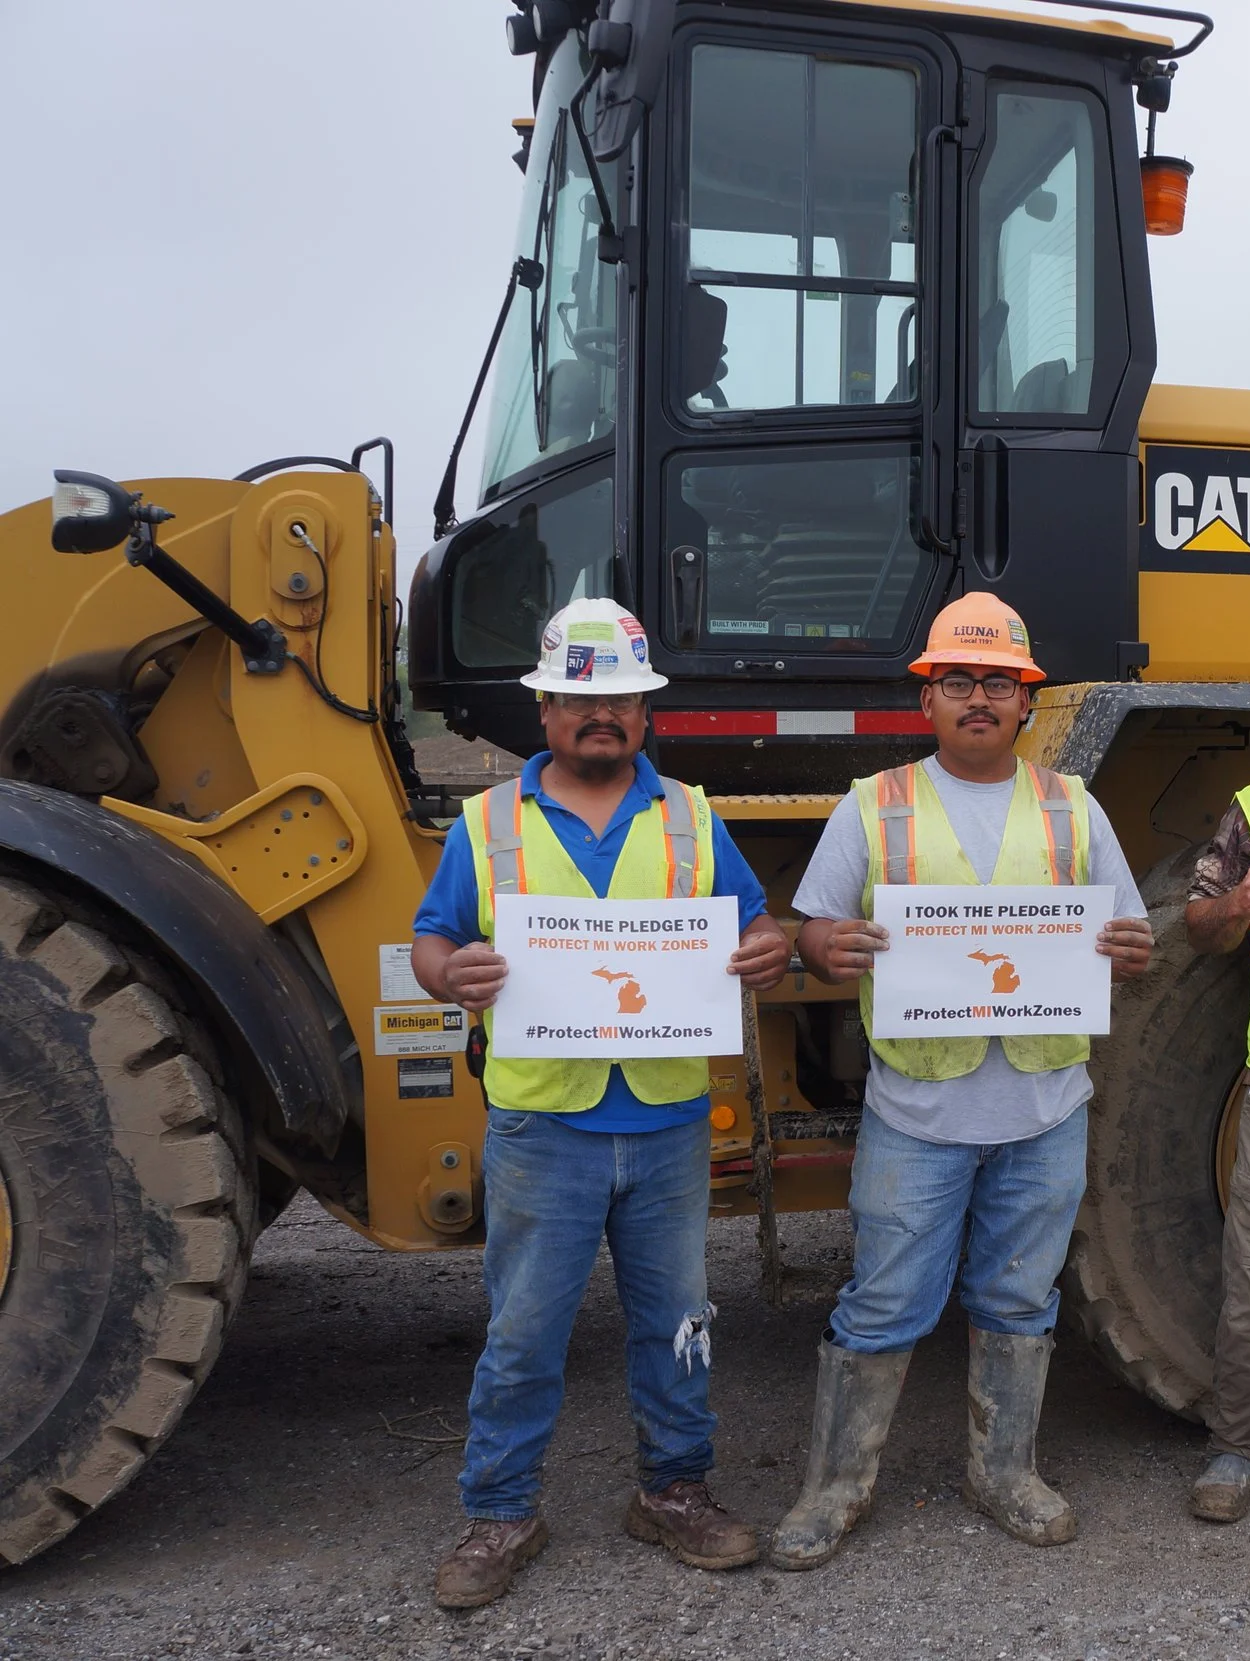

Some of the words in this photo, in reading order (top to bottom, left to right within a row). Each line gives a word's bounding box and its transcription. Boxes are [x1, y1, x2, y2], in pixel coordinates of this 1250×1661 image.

[749, 621, 767, 629] PRIDE
[906, 906, 910, 918] I
[915, 906, 959, 918] TOOK
[965, 906, 993, 918] THE
[998, 905, 1061, 917] PLEDGE
[1065, 904, 1085, 916] TO
[528, 916, 532, 929] I
[537, 917, 580, 931] TOOK
[585, 919, 614, 932] THE
[619, 919, 684, 933] PLEDGE
[688, 918, 708, 931] TO
[905, 926, 967, 936] PROTECT
[971, 925, 988, 935] MI
[992, 924, 1033, 935] WORK
[1037, 923, 1083, 934] ZONES
[528, 937, 589, 950] PROTECT
[593, 940, 609, 951] MI
[614, 940, 657, 951] WORK
[661, 939, 709, 951] ZONES
[904, 1004, 1082, 1020] #ProtectMIWorkZones
[387, 1016, 439, 1029] Michigan
[443, 1015, 462, 1027] CAT
[526, 1025, 713, 1039] #ProtectMIWorkZones
